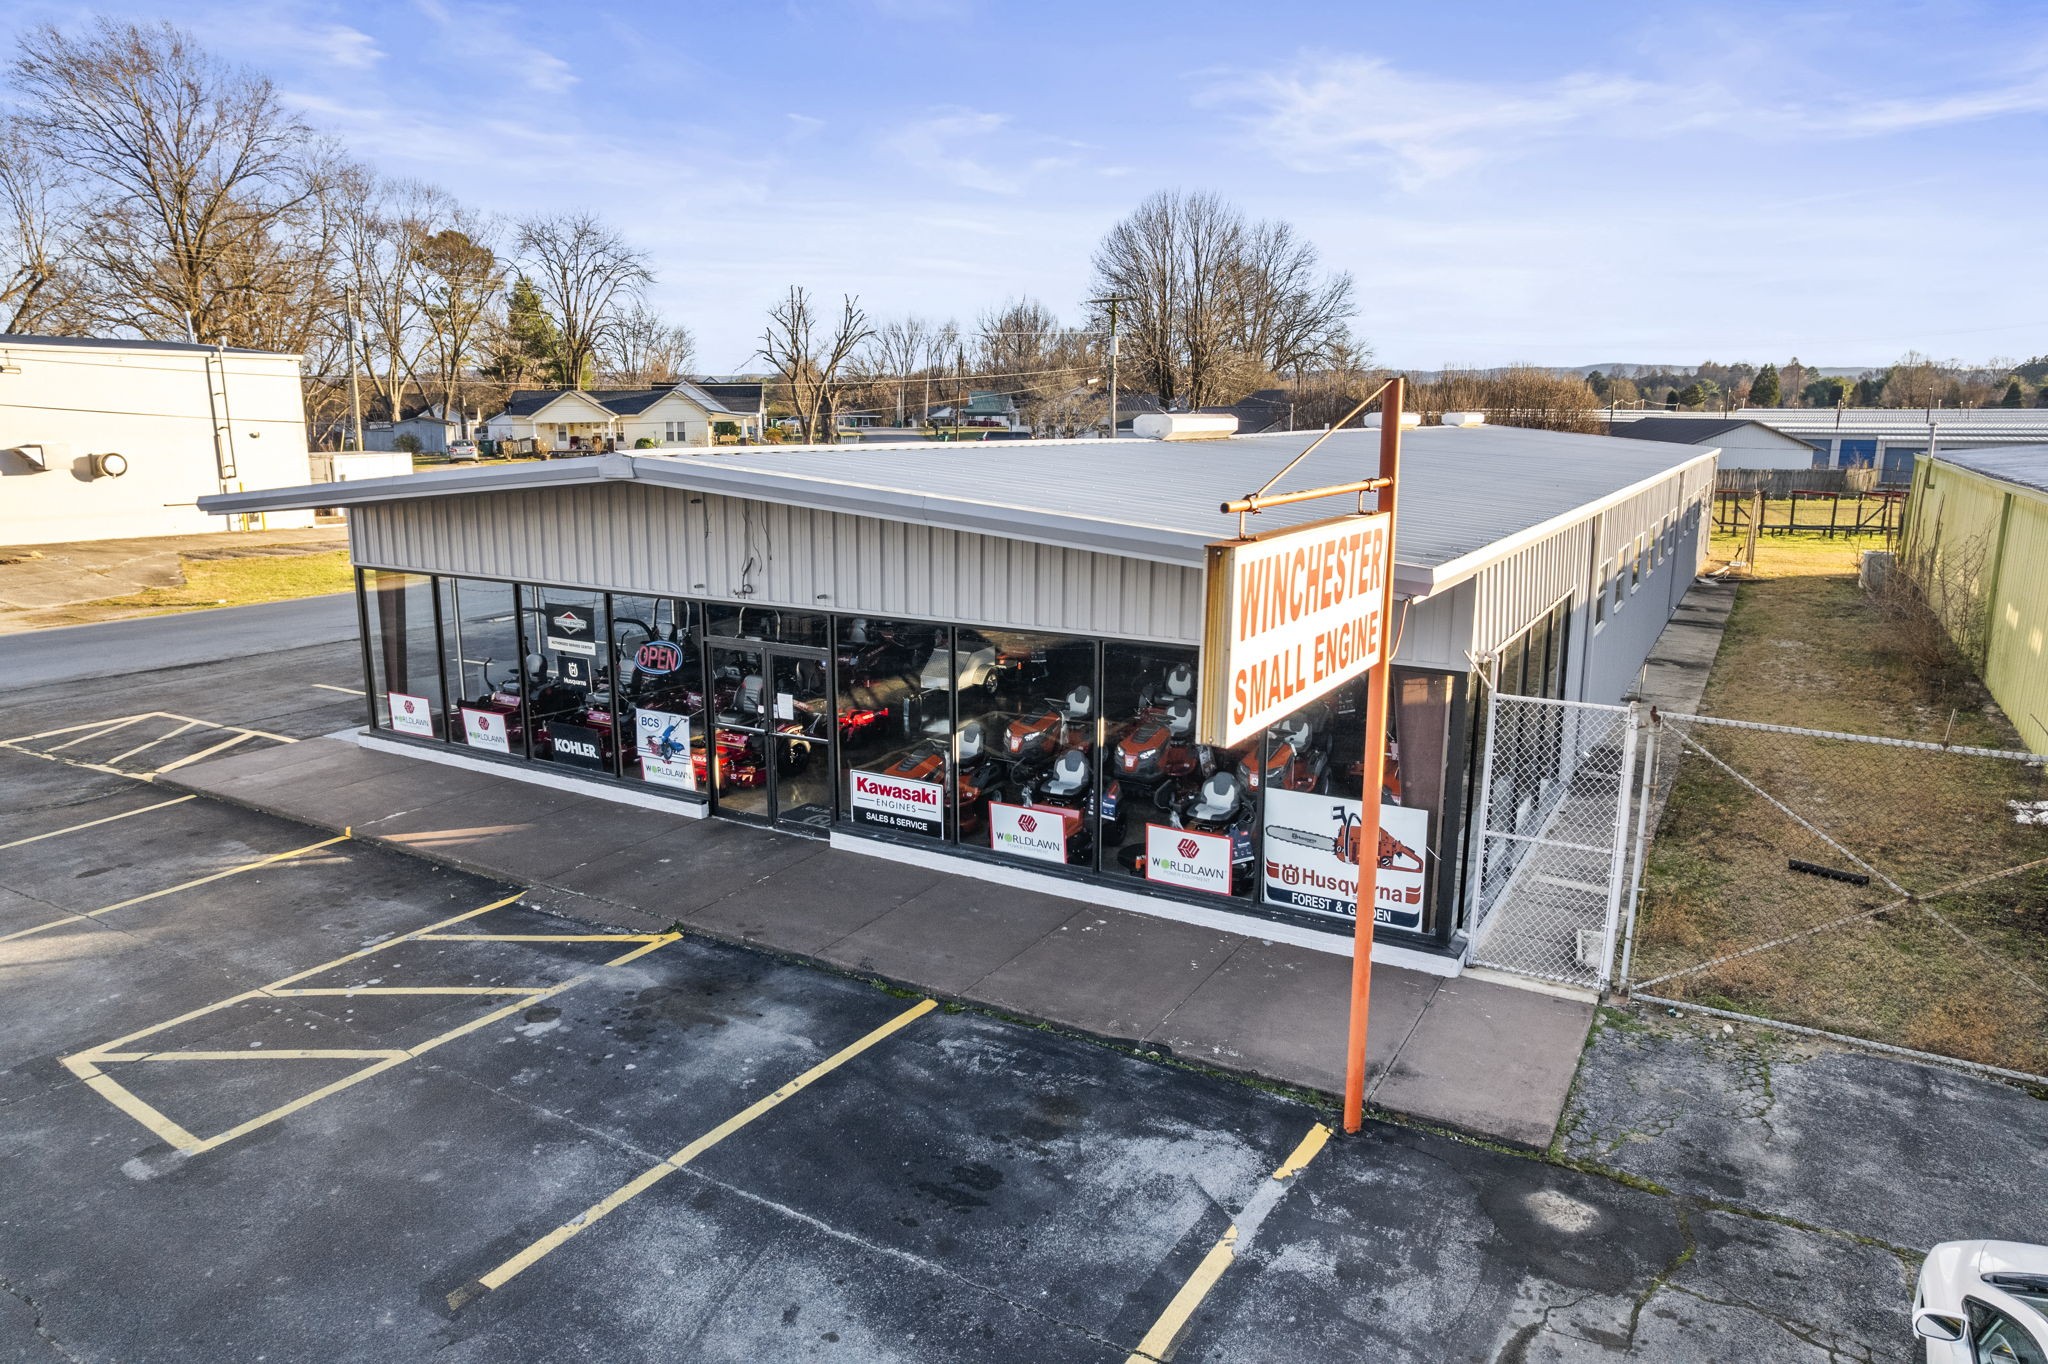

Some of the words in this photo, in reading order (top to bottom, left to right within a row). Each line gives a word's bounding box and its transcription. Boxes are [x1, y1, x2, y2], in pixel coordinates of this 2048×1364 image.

[1240, 528, 1385, 642] WINCHESTER
[638, 645, 677, 672] OPEN
[1233, 643, 1306, 726] SMALL
[1313, 610, 1379, 685] ENGINE
[641, 716, 660, 729] BCS
[856, 776, 936, 805] Kawasaki
[876, 798, 916, 813] ENGINES
[866, 811, 888, 824] SALES
[889, 816, 895, 824] &
[896, 817, 928, 831] SERVICE
[996, 831, 1060, 852] WORLDLAWN
[1152, 856, 1224, 880] WORLDLAWN
[1302, 868, 1402, 902] Husqvna
[1291, 892, 1332, 910] FOREST
[1335, 901, 1343, 913] &
[1348, 904, 1391, 923] GEN
